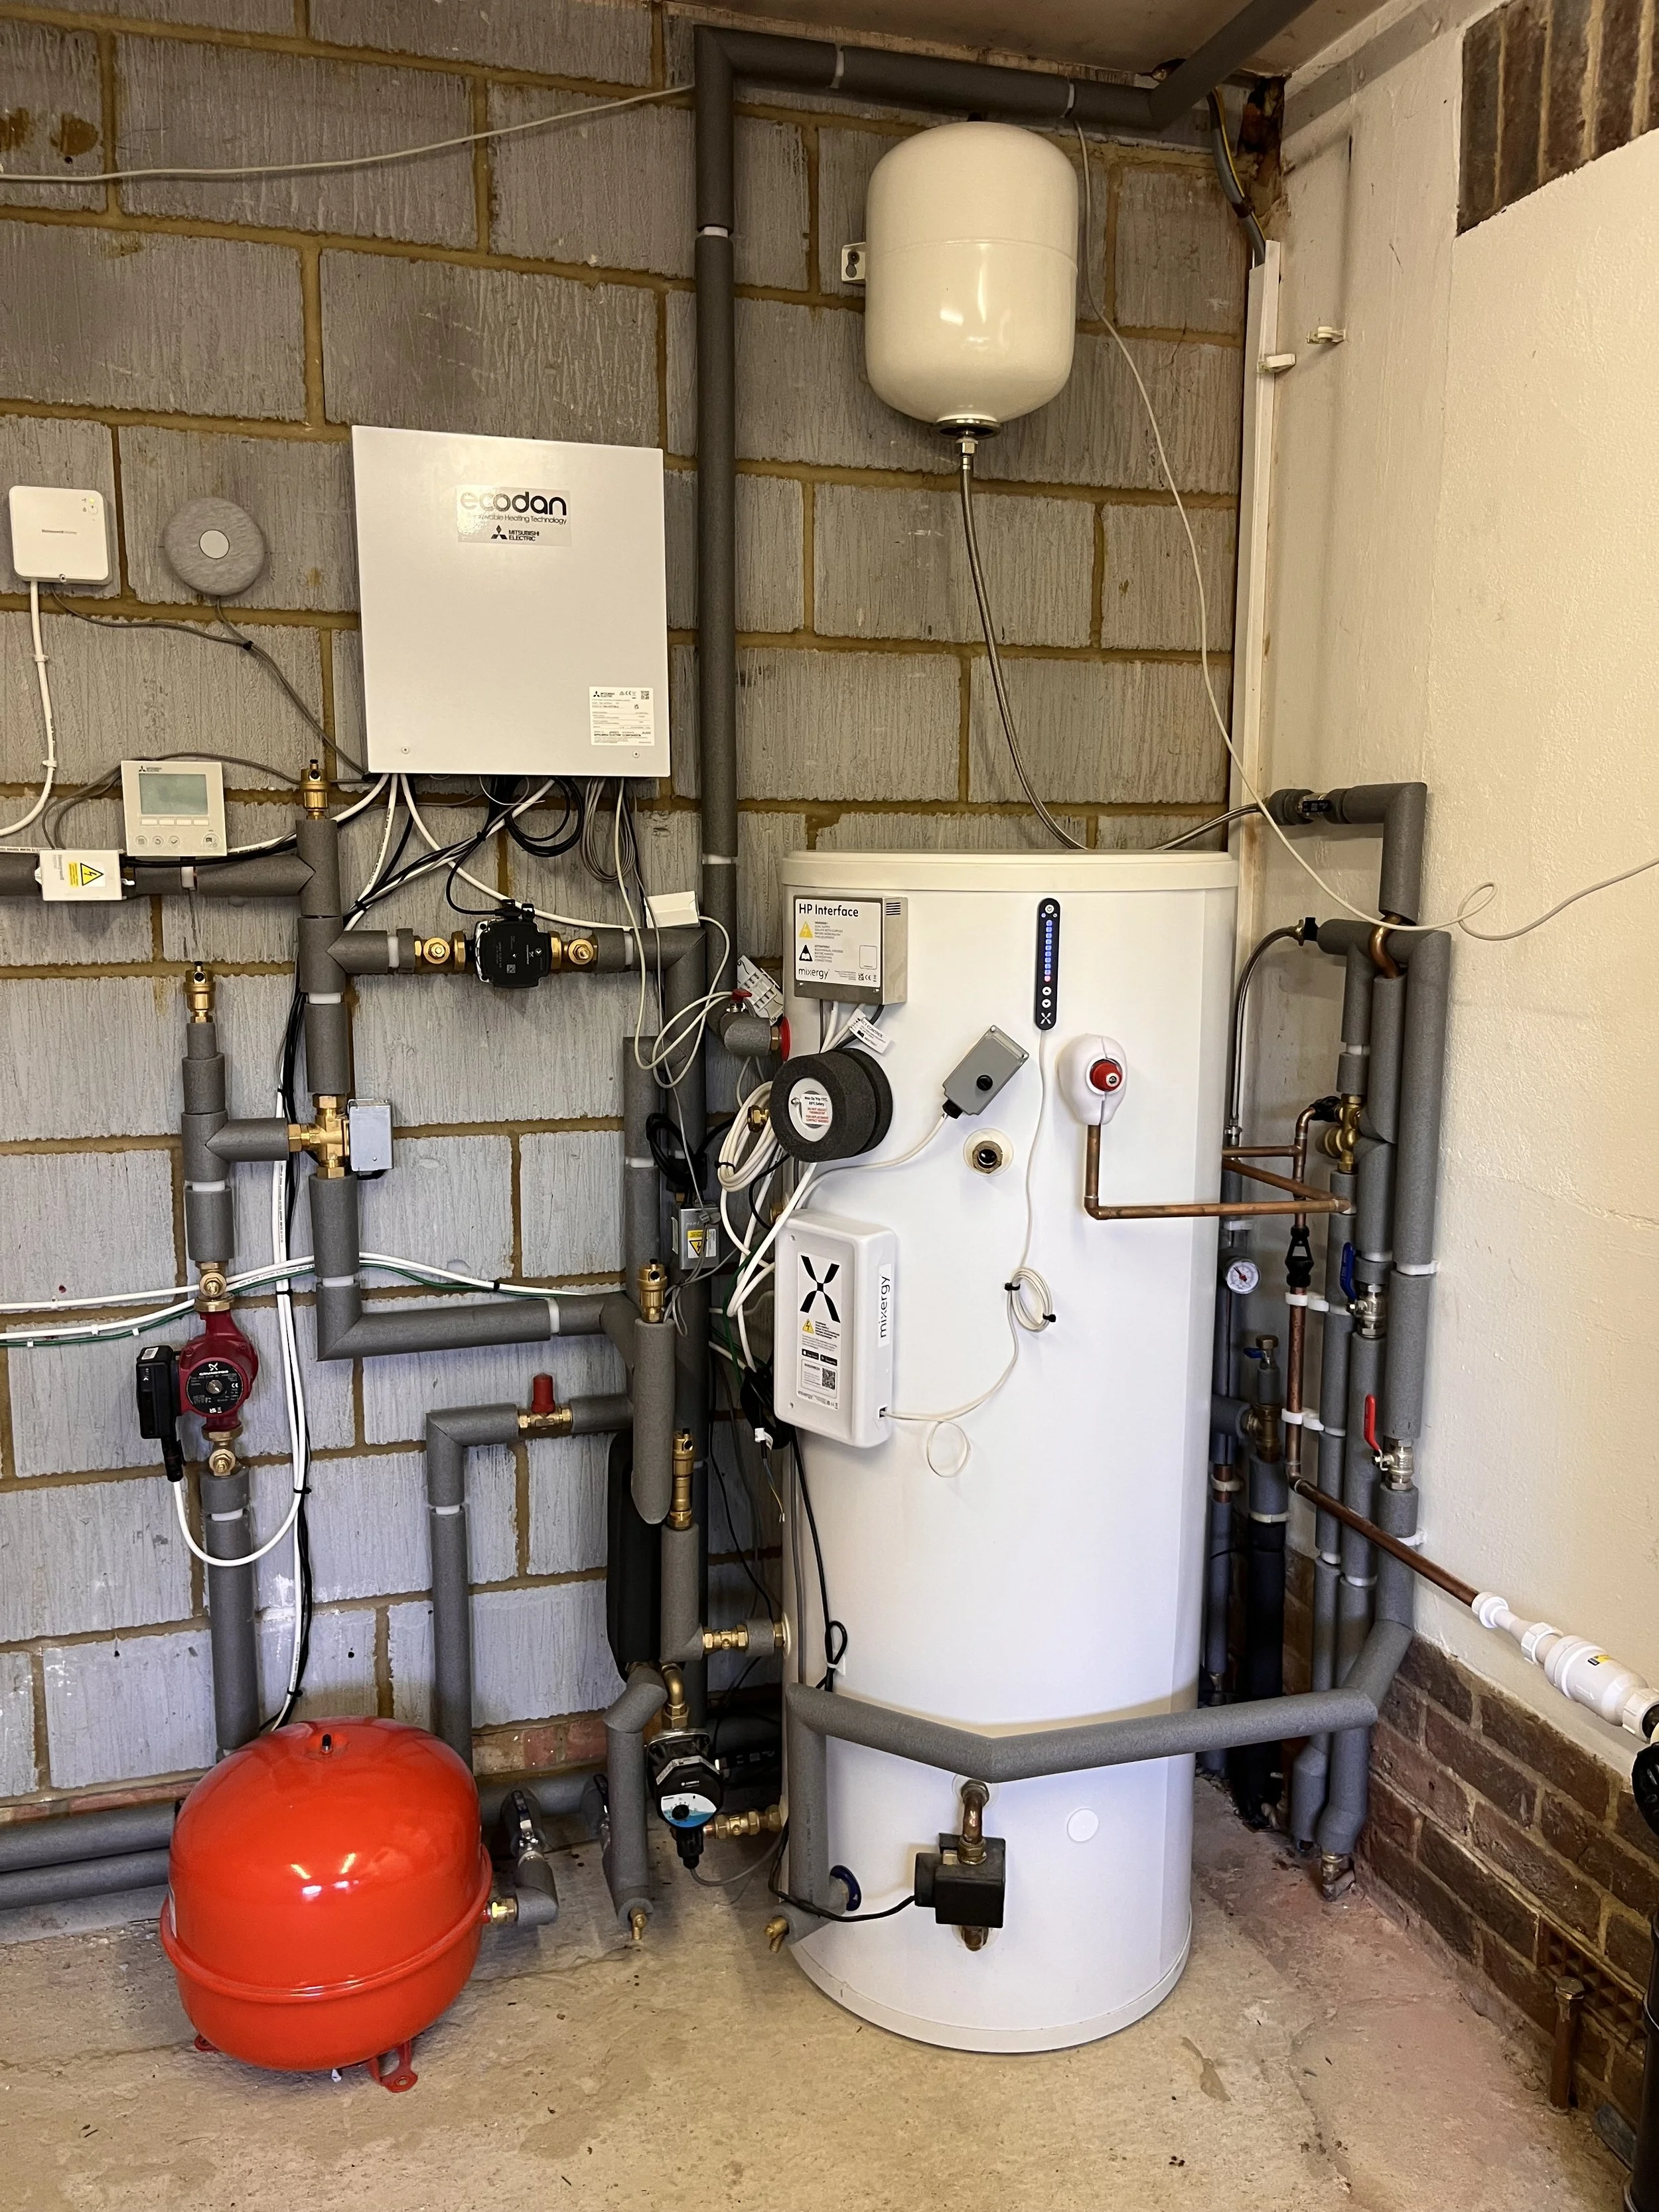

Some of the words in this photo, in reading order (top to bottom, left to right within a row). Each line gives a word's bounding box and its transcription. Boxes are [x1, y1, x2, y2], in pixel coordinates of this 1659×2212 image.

[461, 491, 567, 516] ecodan
[504, 514, 530, 524] Heating
[530, 516, 567, 526] Technology
[799, 903, 812, 915] HP
[815, 904, 859, 917] Interface
[798, 968, 829, 980] mixergy
[879, 1276, 891, 1338] mixergy
